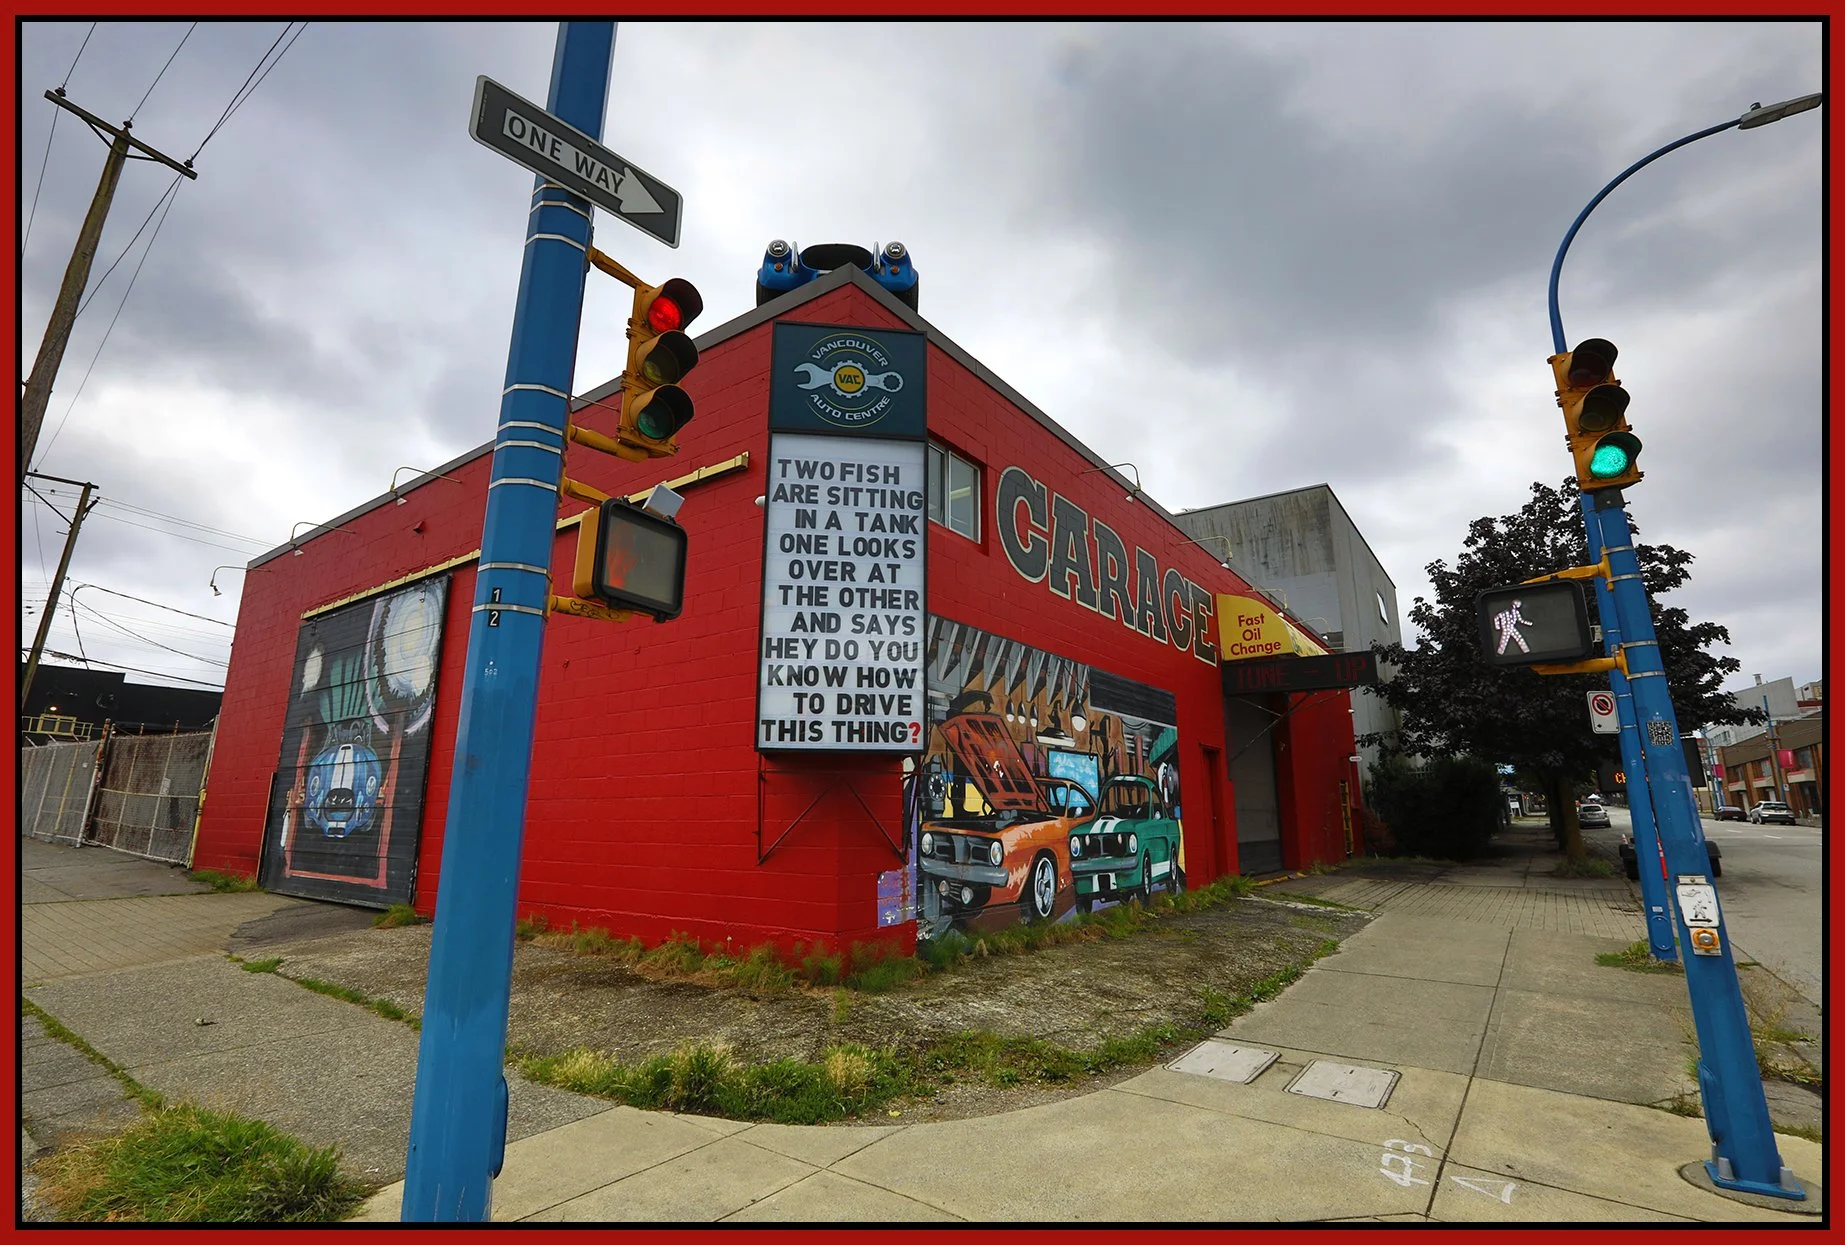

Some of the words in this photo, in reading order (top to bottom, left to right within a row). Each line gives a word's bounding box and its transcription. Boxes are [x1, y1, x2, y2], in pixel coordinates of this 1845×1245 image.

[508, 116, 562, 161] ONE
[575, 151, 624, 194] WAY
[811, 339, 888, 367] VANCOUVER
[837, 373, 861, 385] VAC
[810, 394, 841, 419] AUTO
[845, 396, 891, 421] CENTRE
[778, 459, 834, 480] TWO
[840, 463, 899, 485] FISH
[772, 483, 819, 504] ARE
[827, 487, 923, 511] SITTING
[795, 509, 817, 529] IN
[825, 511, 842, 531] A
[855, 512, 919, 534] TANK
[780, 533, 827, 555] ONE
[839, 536, 916, 559] LOOKS
[789, 560, 855, 582] OVER
[868, 563, 900, 583] AT
[778, 585, 828, 606] THE
[839, 587, 919, 610] OTHER
[790, 612, 841, 633] AND
[851, 614, 916, 636] SAYS
[1237, 613, 1265, 627] Fast
[1242, 628, 1261, 642] Oil
[765, 637, 818, 660] HEY
[825, 639, 859, 660] DO
[868, 640, 918, 662] YOU
[1230, 641, 1282, 656] Change
[767, 665, 848, 688] KNOW
[857, 666, 917, 689] HOW
[1236, 664, 1291, 690] TUNE
[1334, 656, 1366, 682] UP
[793, 693, 824, 714] TO
[837, 694, 912, 716] DRIVE
[761, 720, 822, 742] THIS
[831, 721, 920, 743] THING?
